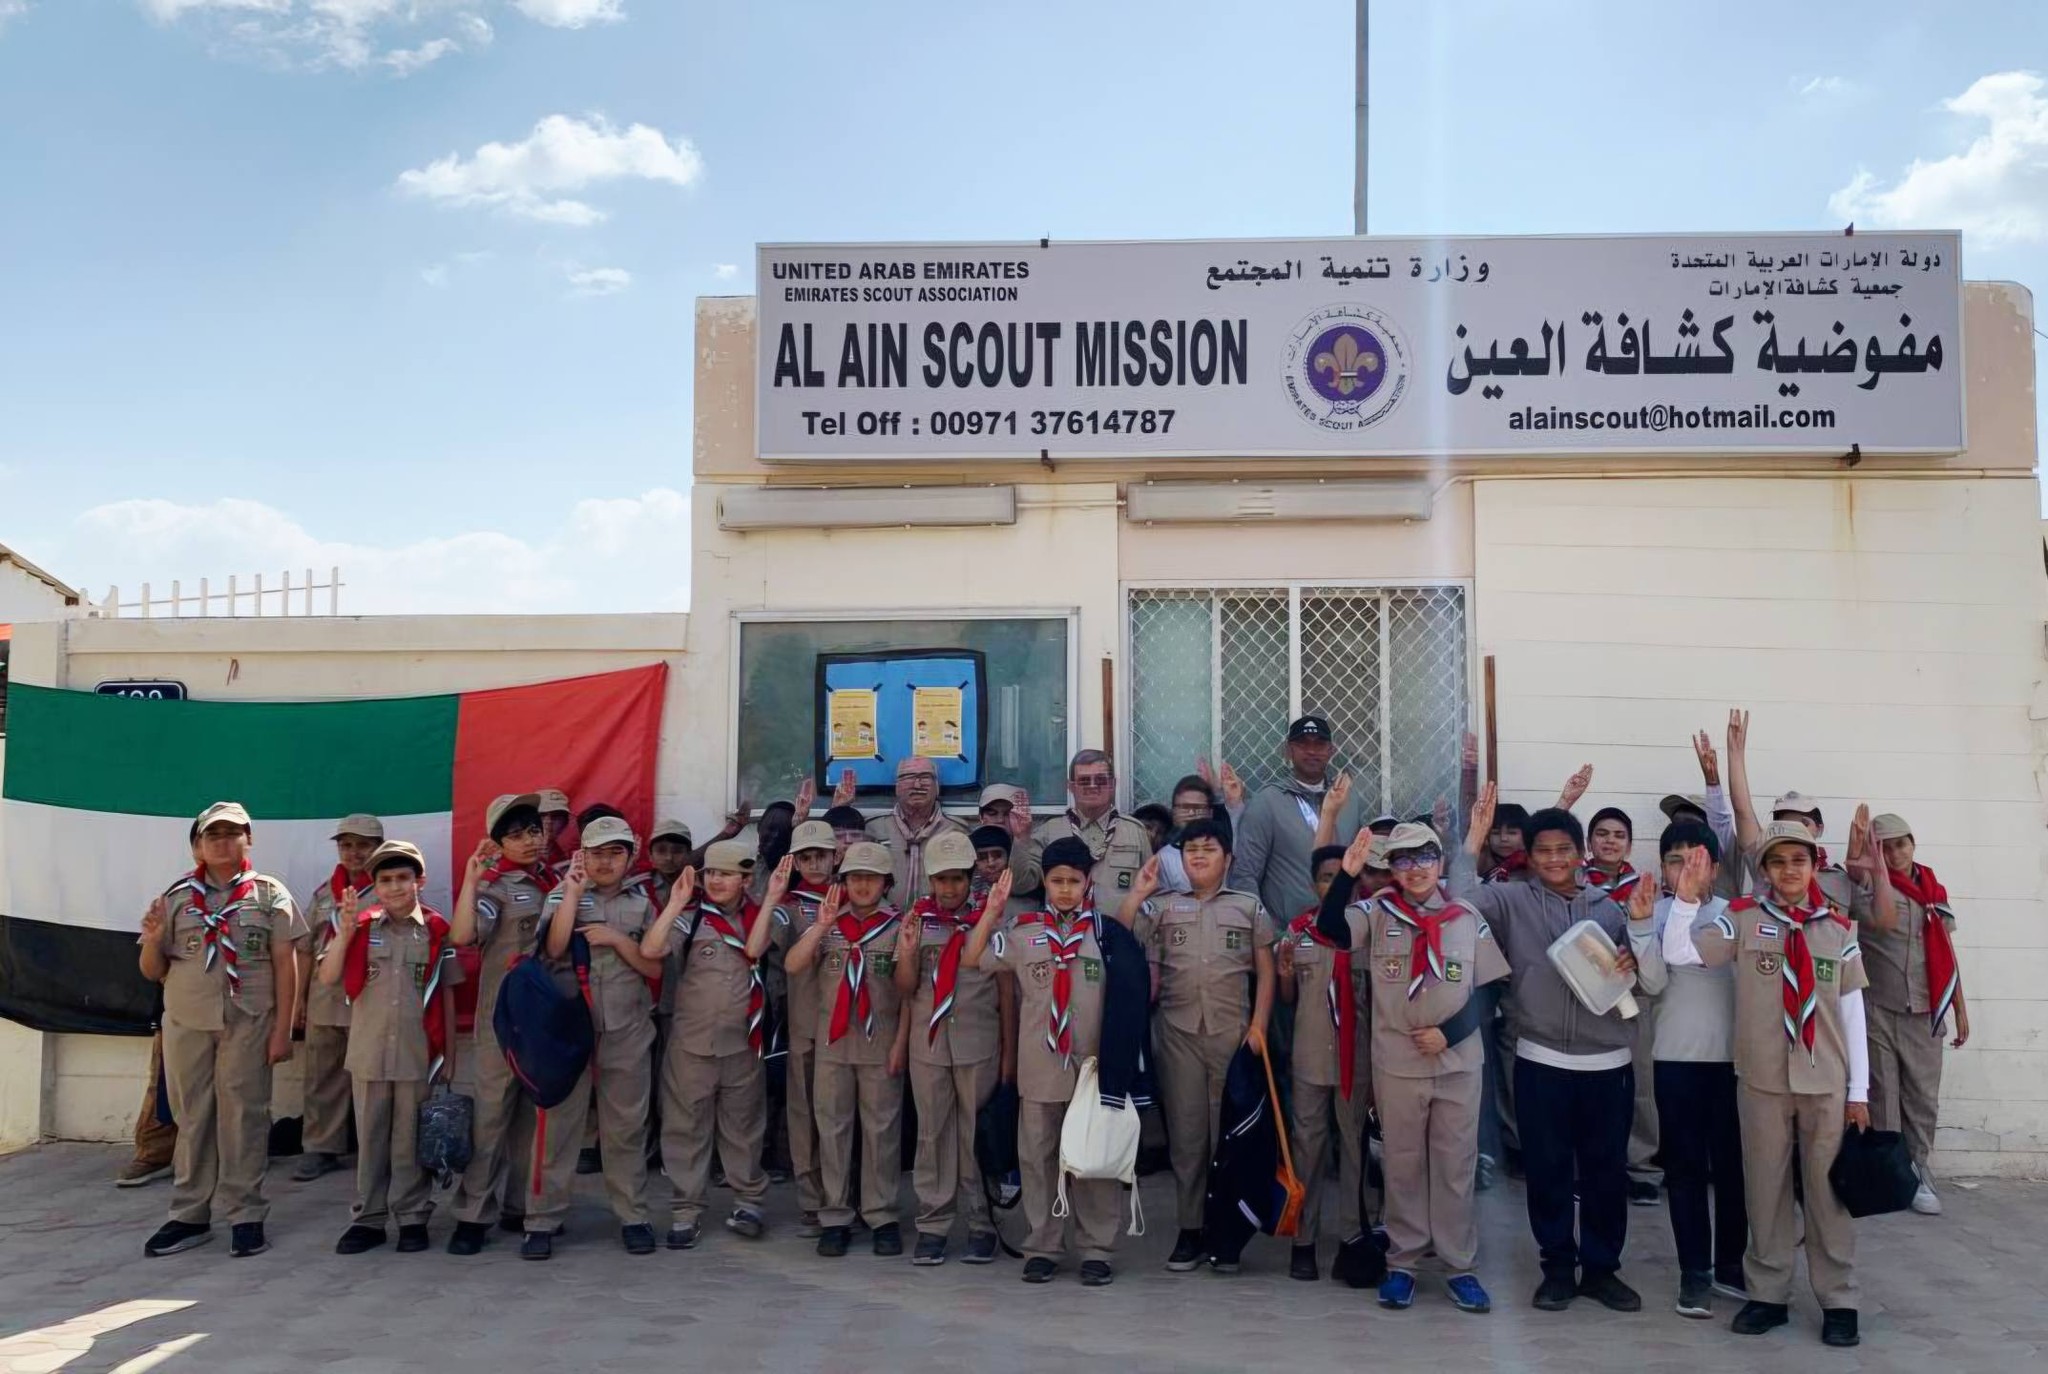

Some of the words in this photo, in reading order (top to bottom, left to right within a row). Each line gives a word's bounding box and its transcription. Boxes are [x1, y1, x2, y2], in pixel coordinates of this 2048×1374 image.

[773, 262, 851, 280] UNITED
[859, 262, 916, 280] ARAB
[923, 261, 1030, 280] EMIRATES
[1320, 257, 1390, 285] تنمية
[1409, 255, 1490, 282] وزارة
[1671, 252, 1735, 268] المتحدة
[1747, 252, 1809, 273] العربية
[1900, 249, 1941, 272] دولة
[1206, 259, 1302, 290] المجتمع
[785, 287, 859, 302] EMIRATES
[863, 287, 914, 302] SCOUT
[918, 286, 1018, 302] ASSOCIATION
[1851, 278, 1903, 299] جمعية
[774, 322, 825, 388] AL
[838, 322, 908, 388] AIN
[922, 321, 1061, 388] SCOUT
[1076, 319, 1248, 387] MISSION
[1581, 308, 1735, 375] كشافة
[1753, 309, 1944, 397] مفوضية
[1446, 318, 1566, 400] العين
[802, 412, 846, 435] Tel
[857, 411, 902, 436] Off
[930, 411, 1017, 436] 00971
[1031, 410, 1175, 435] 37614787
[1509, 404, 1836, 431] alainscout@hotmail.com
